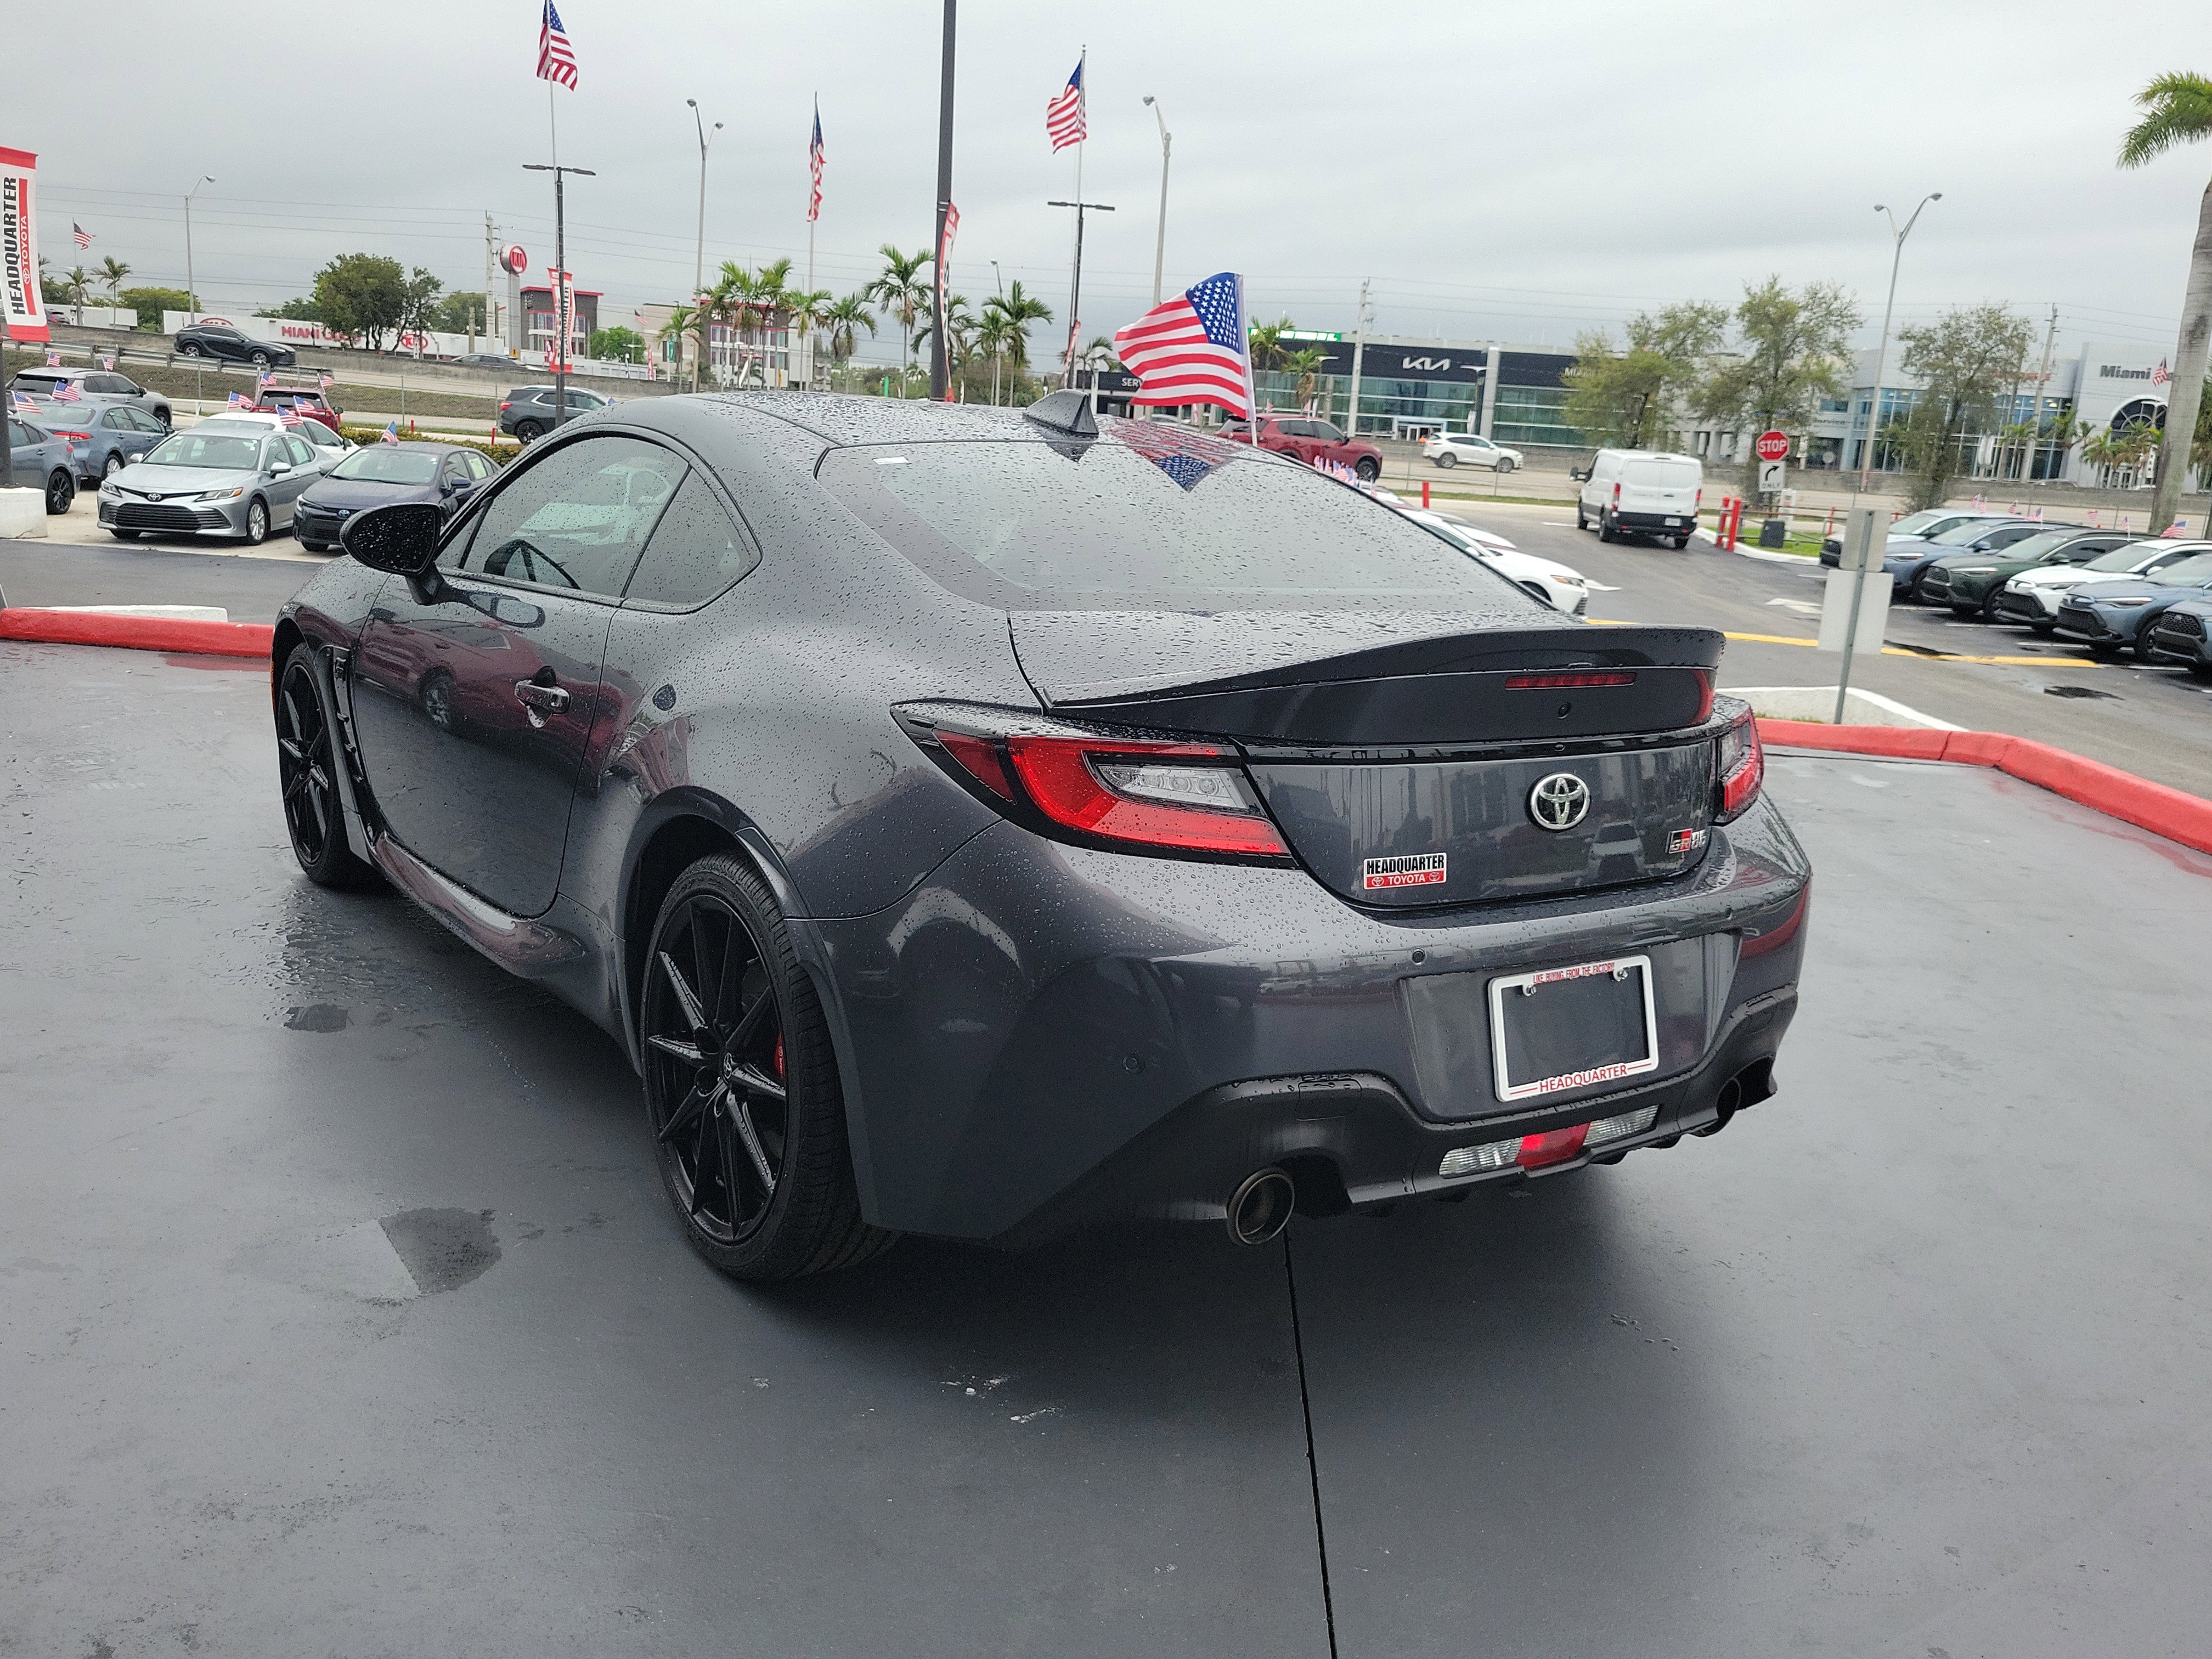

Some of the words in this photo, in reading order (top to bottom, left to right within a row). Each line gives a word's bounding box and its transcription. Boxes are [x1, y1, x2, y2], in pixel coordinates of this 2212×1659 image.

[3, 177, 26, 315] HEADQUARTER
[1403, 357, 1451, 371] KIA
[2100, 365, 2151, 380] Miami
[1758, 439, 1787, 453] STOP
[1367, 855, 1444, 874] HEADQUARTER
[1387, 874, 1426, 885] TOYOTA
[1533, 974, 1544, 984] LIKE
[1546, 970, 1564, 983] BUYING
[1566, 968, 1579, 978] FROM
[1582, 966, 1592, 975] THE
[1539, 1064, 1627, 1093] HEADQUARTER
